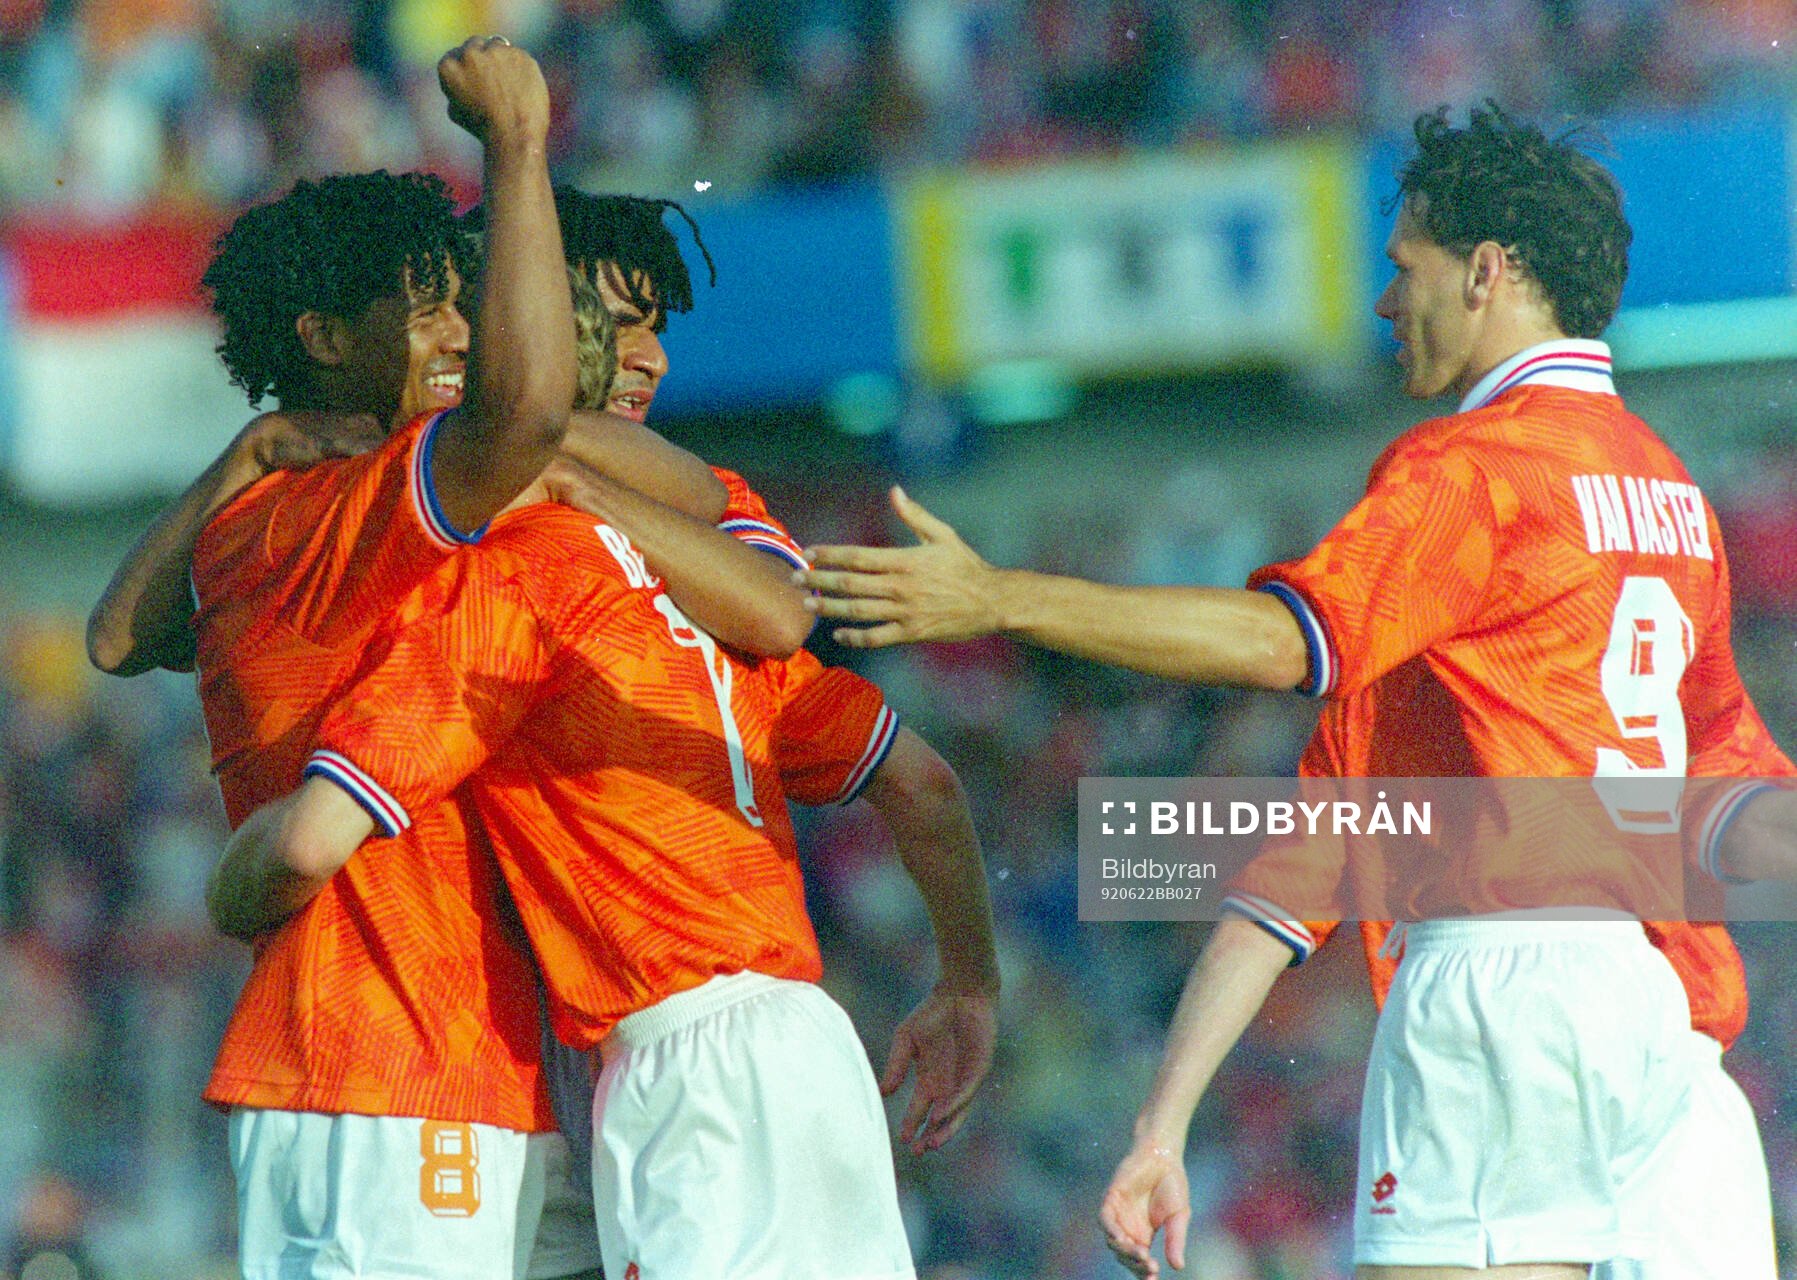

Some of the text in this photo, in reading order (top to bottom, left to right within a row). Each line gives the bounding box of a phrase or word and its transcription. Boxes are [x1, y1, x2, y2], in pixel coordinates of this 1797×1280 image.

[1571, 474, 1714, 561] VAN BASTEN
[1592, 575, 1695, 834] 9
[419, 1119, 481, 1218] 8
